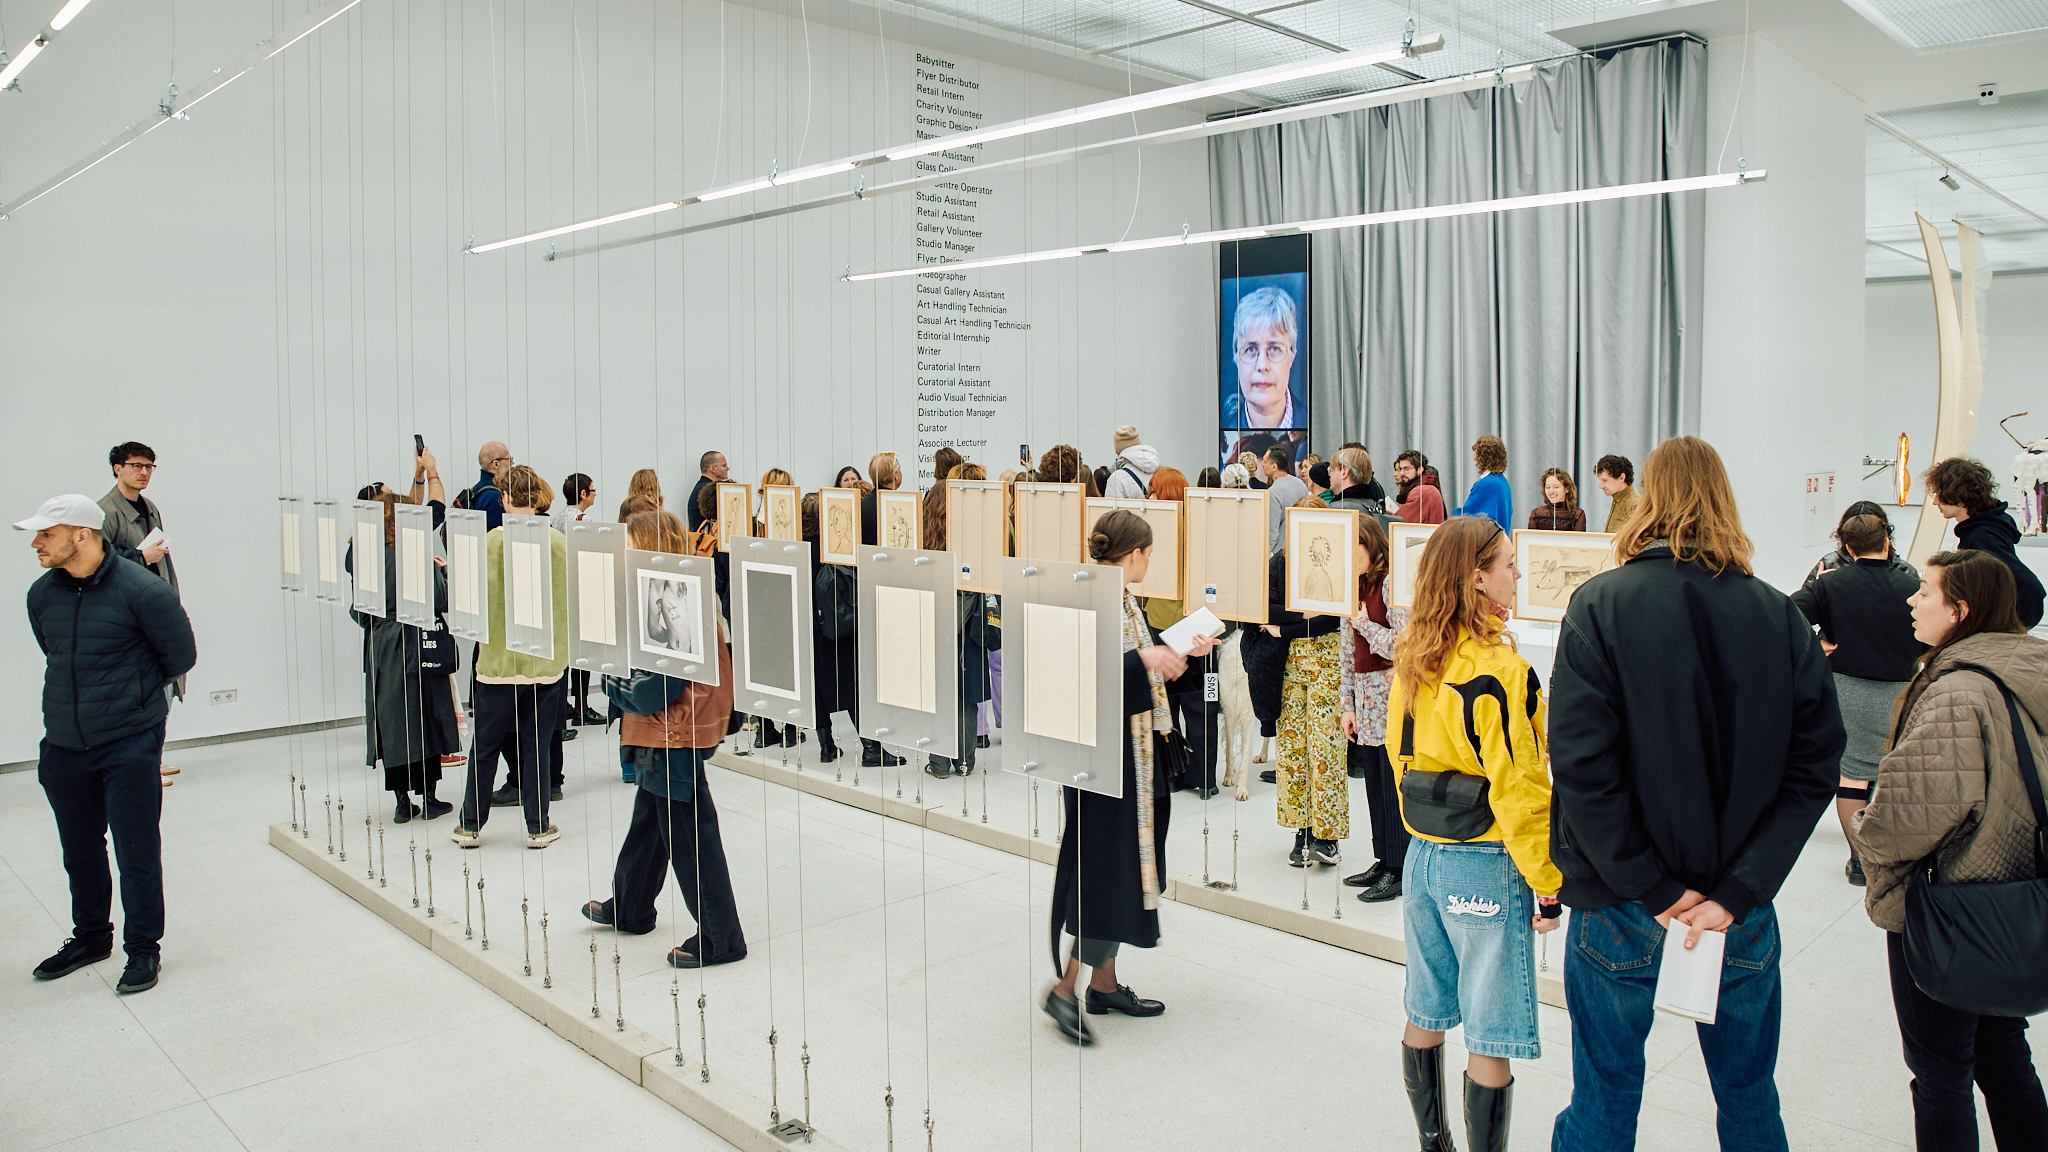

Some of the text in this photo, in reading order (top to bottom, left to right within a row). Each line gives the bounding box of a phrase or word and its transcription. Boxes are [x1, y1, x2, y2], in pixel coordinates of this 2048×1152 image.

[916, 53, 955, 70] Babysitter
[916, 69, 979, 90] Flyer Distributor
[916, 84, 965, 101] Retail Intern
[916, 99, 983, 120] Charity Volunteer
[916, 114, 947, 128] Graphic
[941, 150, 975, 163] Assistant
[916, 160, 937, 172] Glass
[960, 182, 993, 195] Operator
[916, 191, 977, 208] Studio Assistant
[917, 206, 975, 223] Retail Assistant
[916, 222, 983, 239] Gallery Volunteer
[916, 238, 975, 254] Studio Manager
[917, 253, 937, 264] Flyer
[916, 284, 1005, 300] Casual Gallery Assistant
[917, 299, 1007, 314] Art Handling Technician
[917, 315, 1031, 330] Casual Art Handling Technician
[917, 330, 991, 344] Editorial Internship
[917, 346, 941, 356] Writer
[917, 361, 981, 372] Curatorial Intern
[917, 377, 991, 388] Curatorial Assistant
[918, 392, 1007, 402] Audio Visual Technician
[918, 407, 996, 418] Distribution Manager
[918, 423, 948, 432] Curator
[918, 438, 987, 448] Associate Lecturer
[422, 640, 437, 649] LIES
[1207, 676, 1216, 699] SMC
[1446, 894, 1501, 917] Dickies
[780, 1124, 804, 1136] 17
